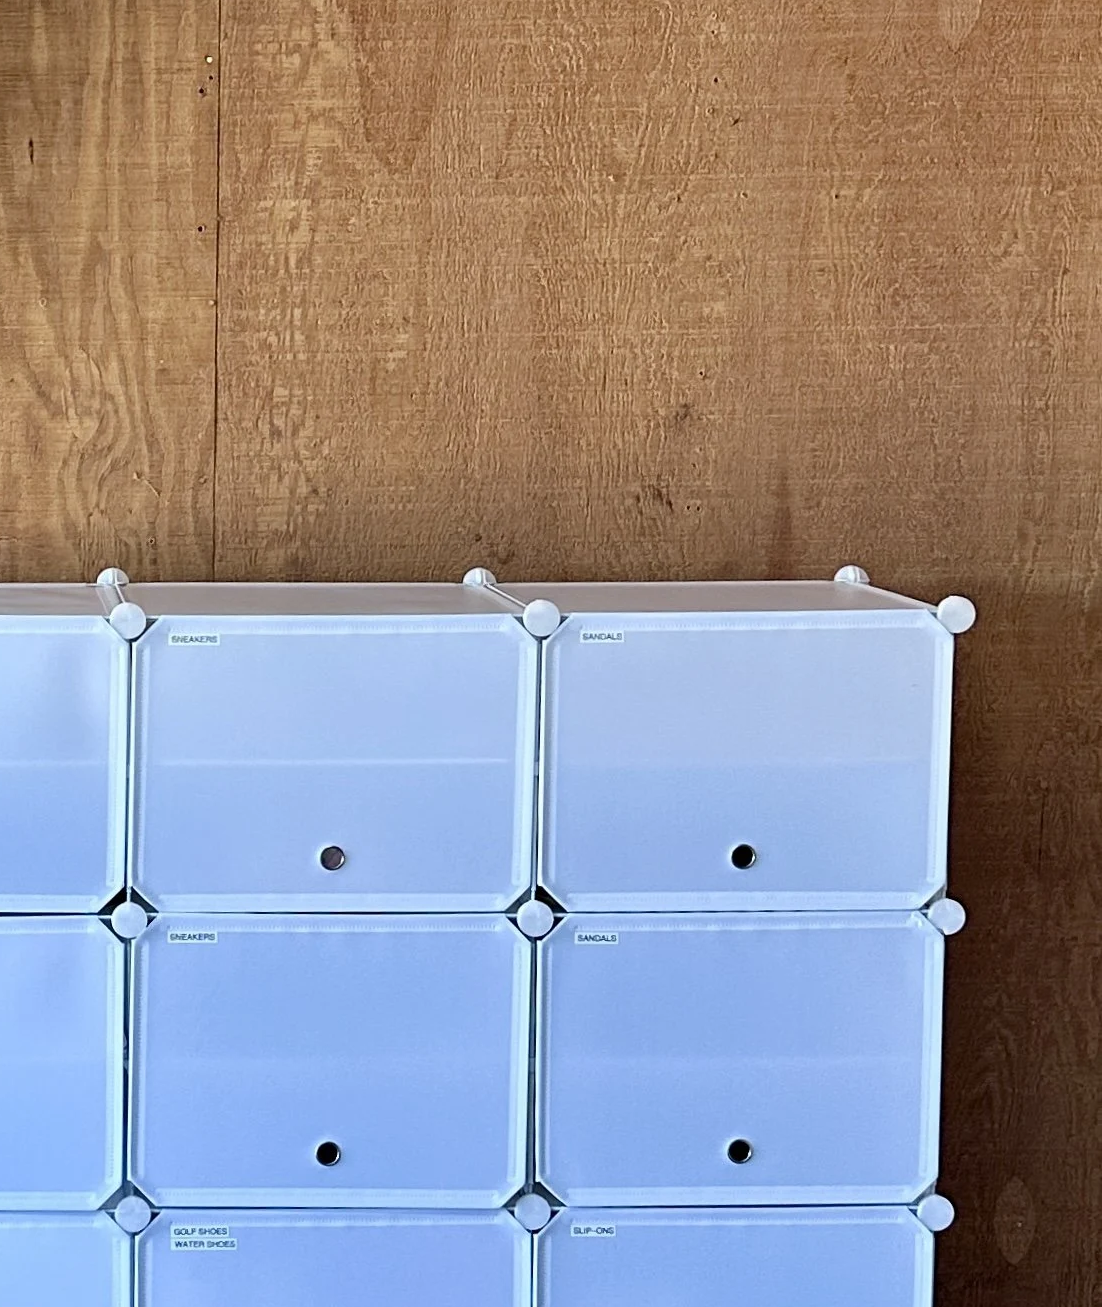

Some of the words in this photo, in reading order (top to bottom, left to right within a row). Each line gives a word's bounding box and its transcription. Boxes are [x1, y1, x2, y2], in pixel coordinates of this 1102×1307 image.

[171, 635, 218, 644] SNEAKERS
[582, 632, 623, 641] SANDALS
[169, 933, 216, 941] SNEAKERS
[577, 934, 617, 942] SANDALS
[198, 1227, 228, 1235] SHOES
[573, 1226, 614, 1235] SLIP-ONS
[174, 1240, 205, 1248] WATER
[206, 1240, 236, 1248] SHOES
